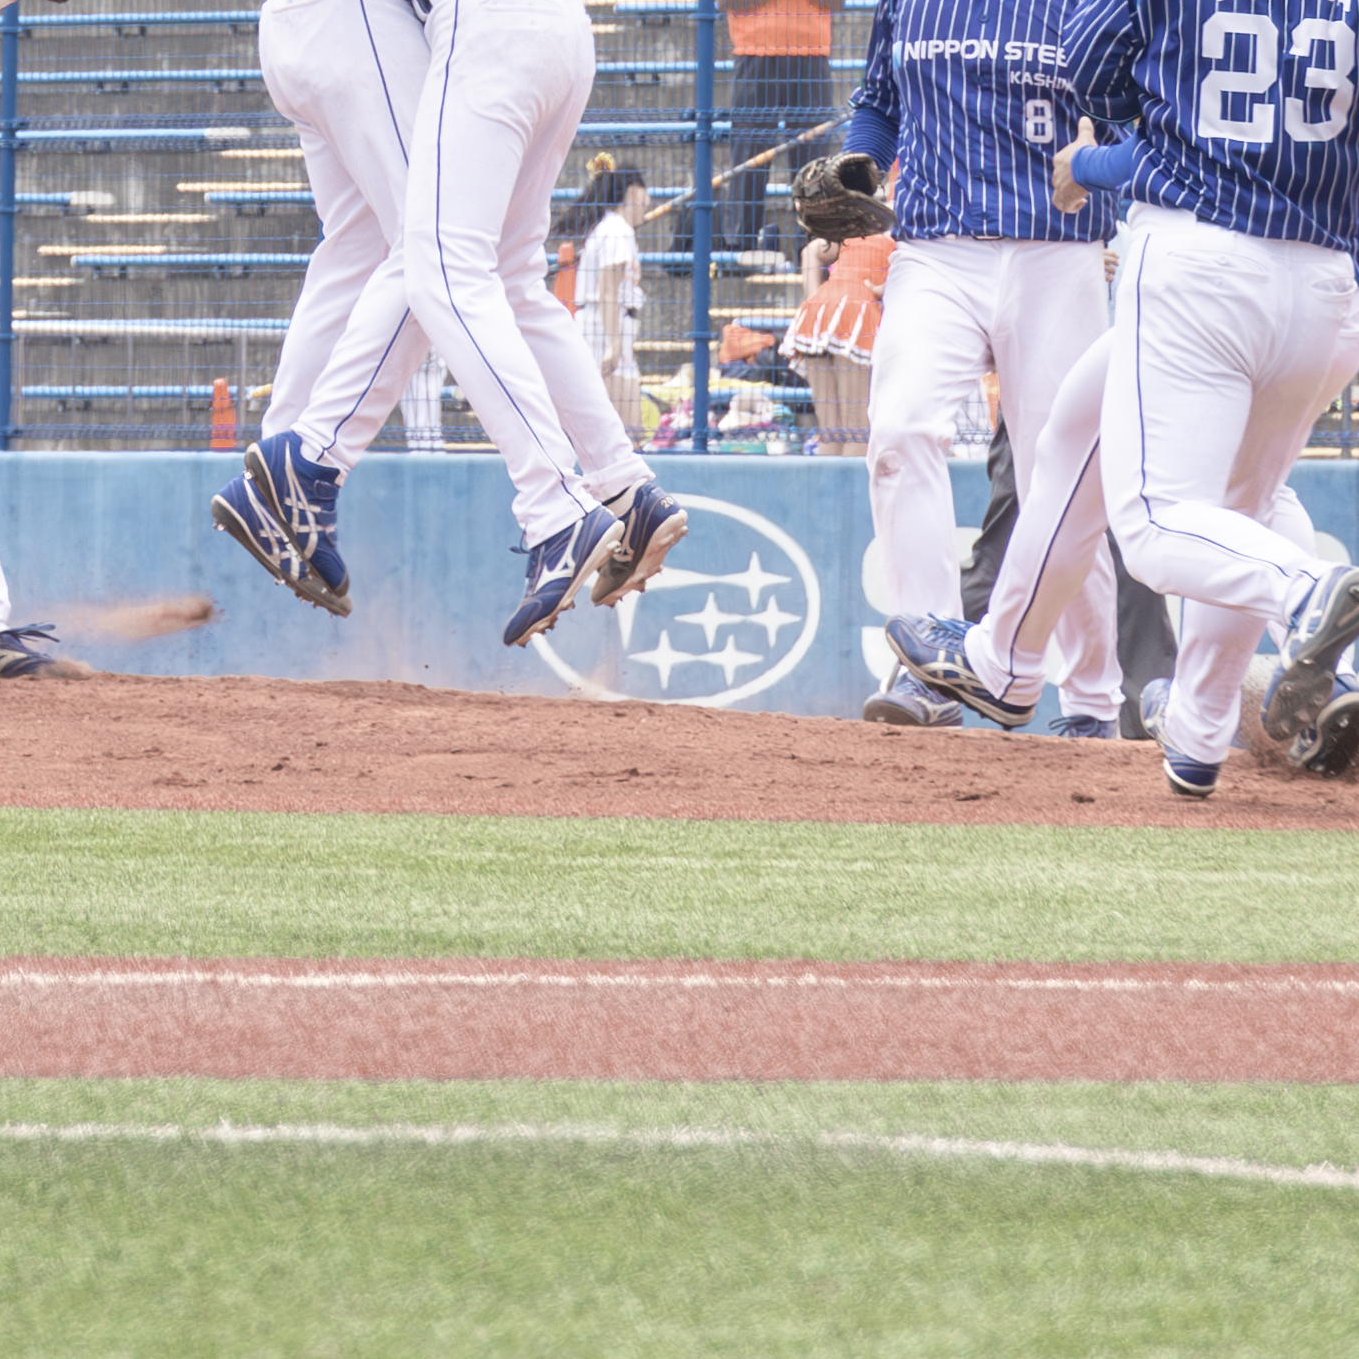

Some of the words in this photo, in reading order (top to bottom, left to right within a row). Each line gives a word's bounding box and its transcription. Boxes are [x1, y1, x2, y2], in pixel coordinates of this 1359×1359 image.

[903, 39, 999, 62] NIPPON
[1004, 42, 1069, 68] STEE
[1010, 71, 1076, 93] KASHIM
[1197, 11, 1357, 144] 23
[1026, 99, 1054, 144] 8
